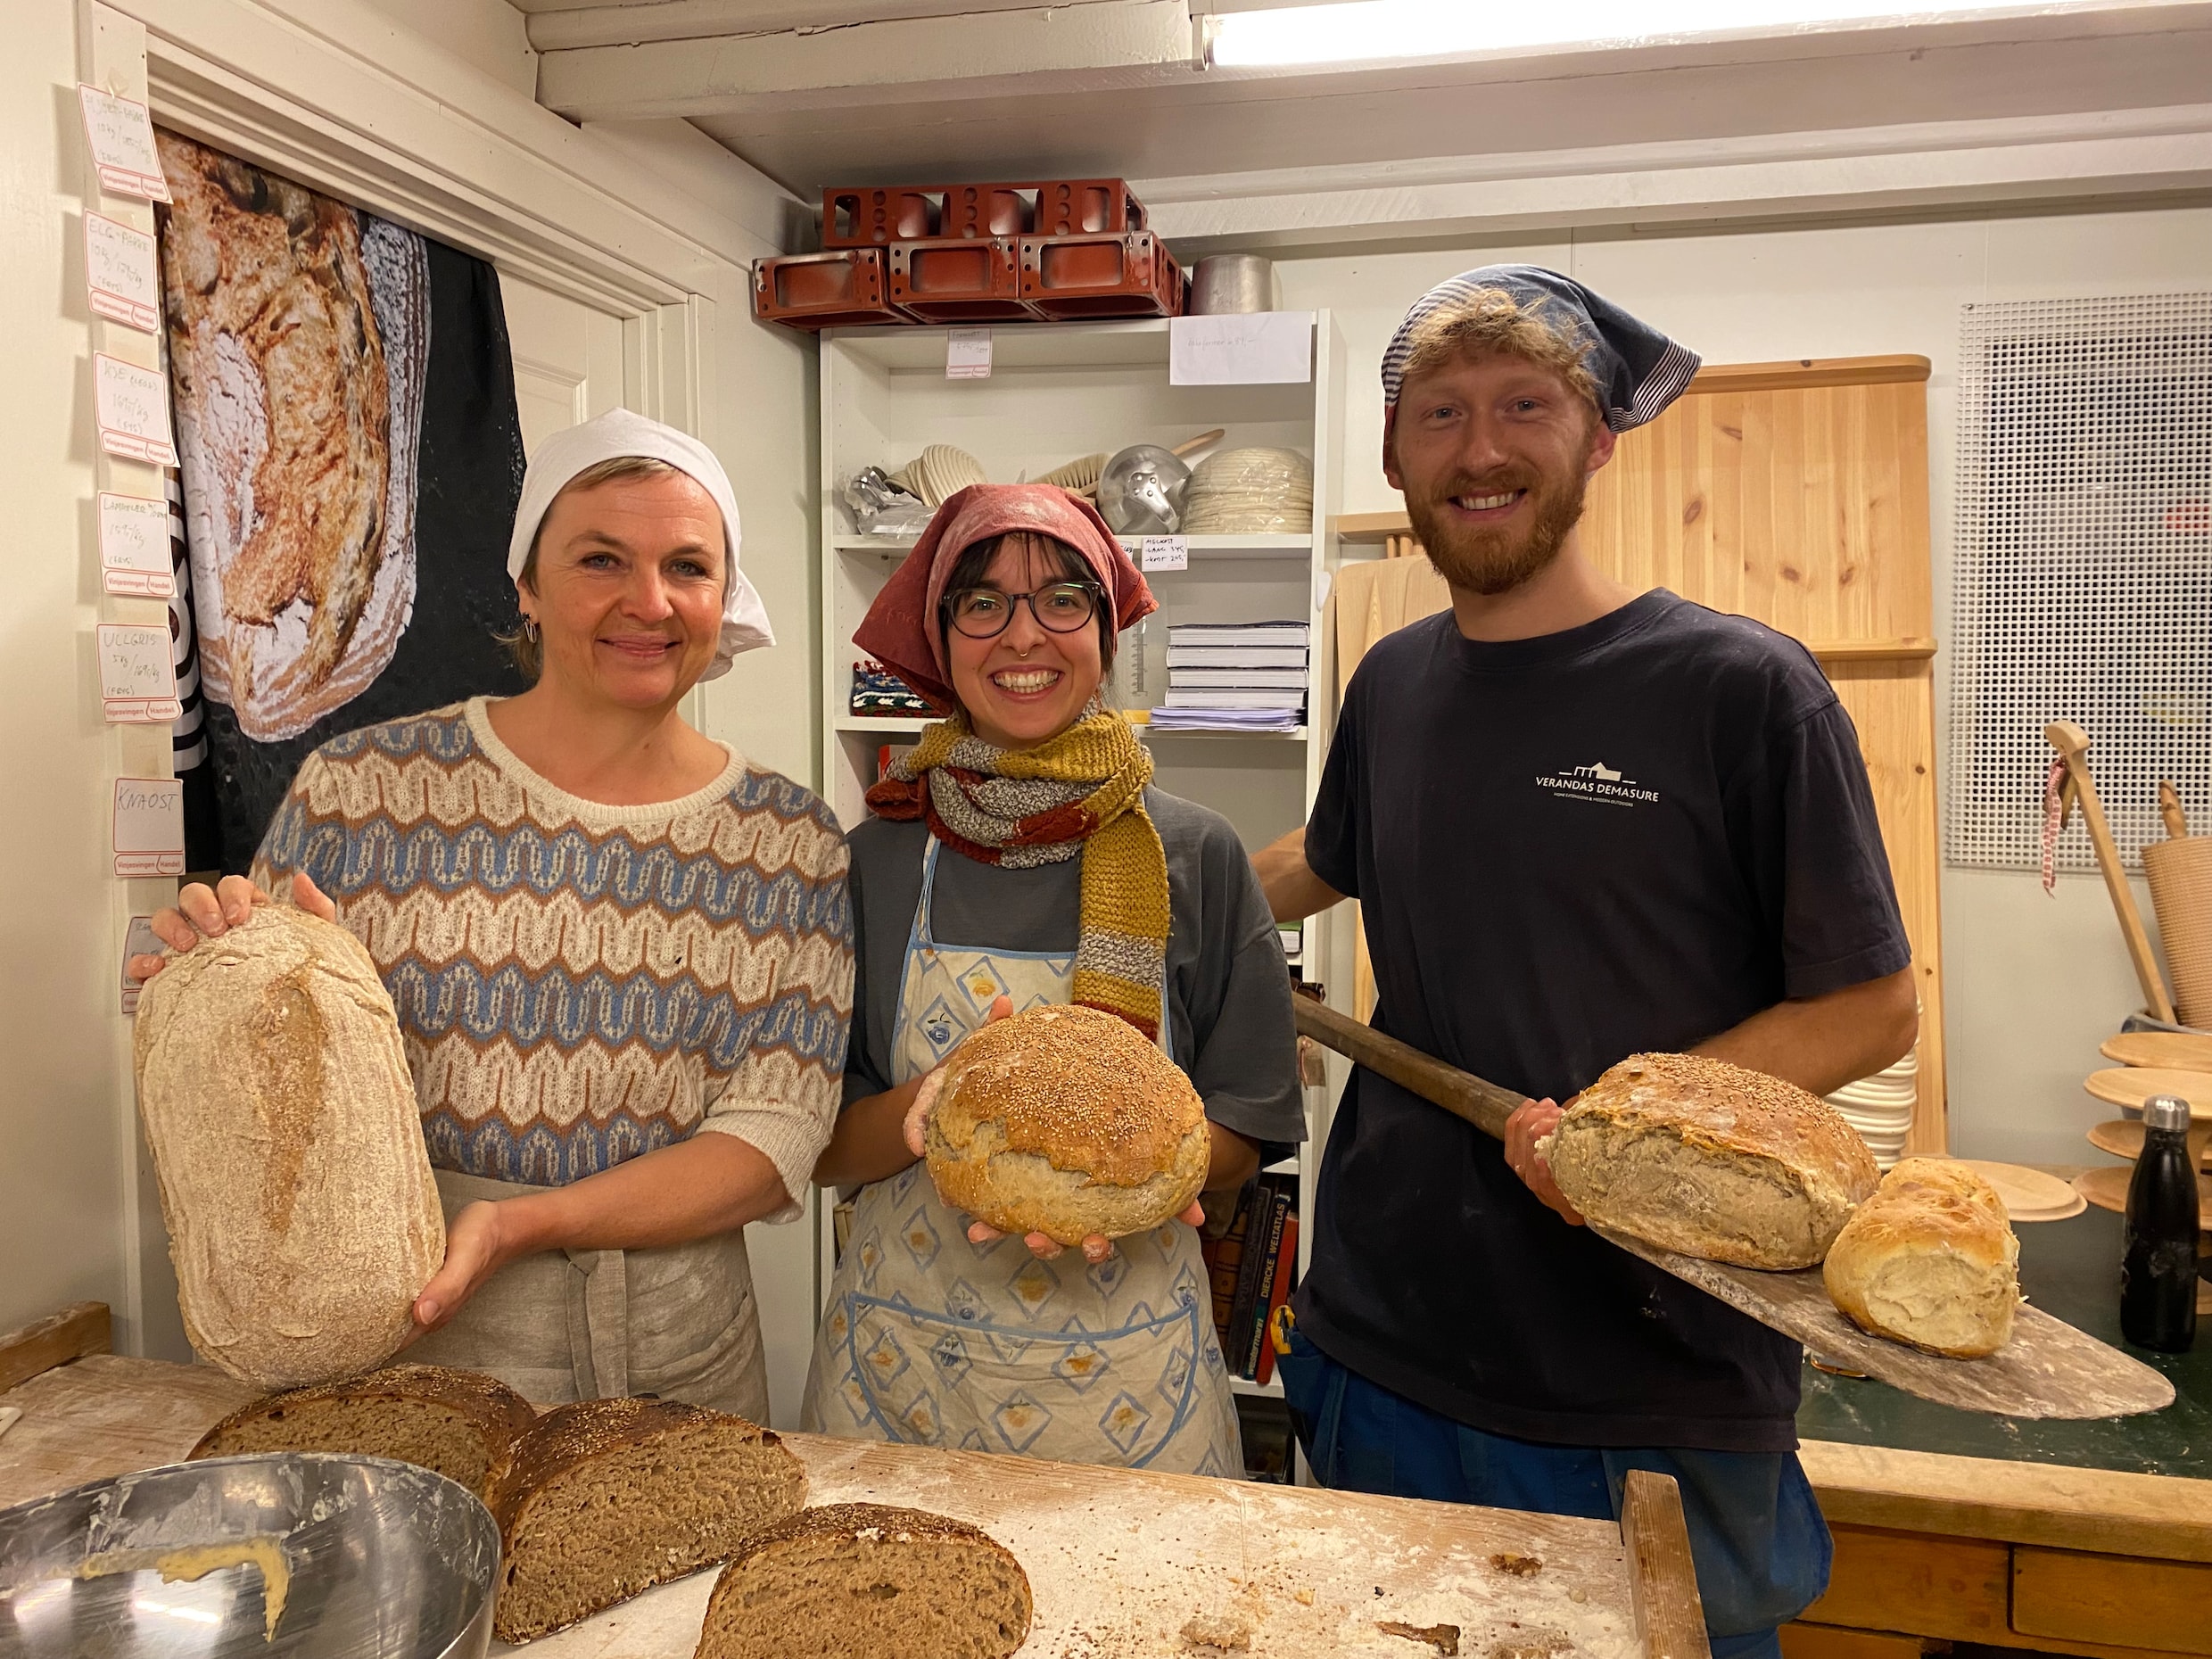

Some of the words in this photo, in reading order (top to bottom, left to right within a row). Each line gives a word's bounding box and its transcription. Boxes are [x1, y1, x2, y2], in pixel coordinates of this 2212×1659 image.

[1536, 777, 1594, 792] VERANDAS
[1597, 783, 1659, 802] DEMASURE
[1260, 1258, 1275, 1299] DIERCKE
[1268, 1203, 1285, 1254] WELTATLAS
